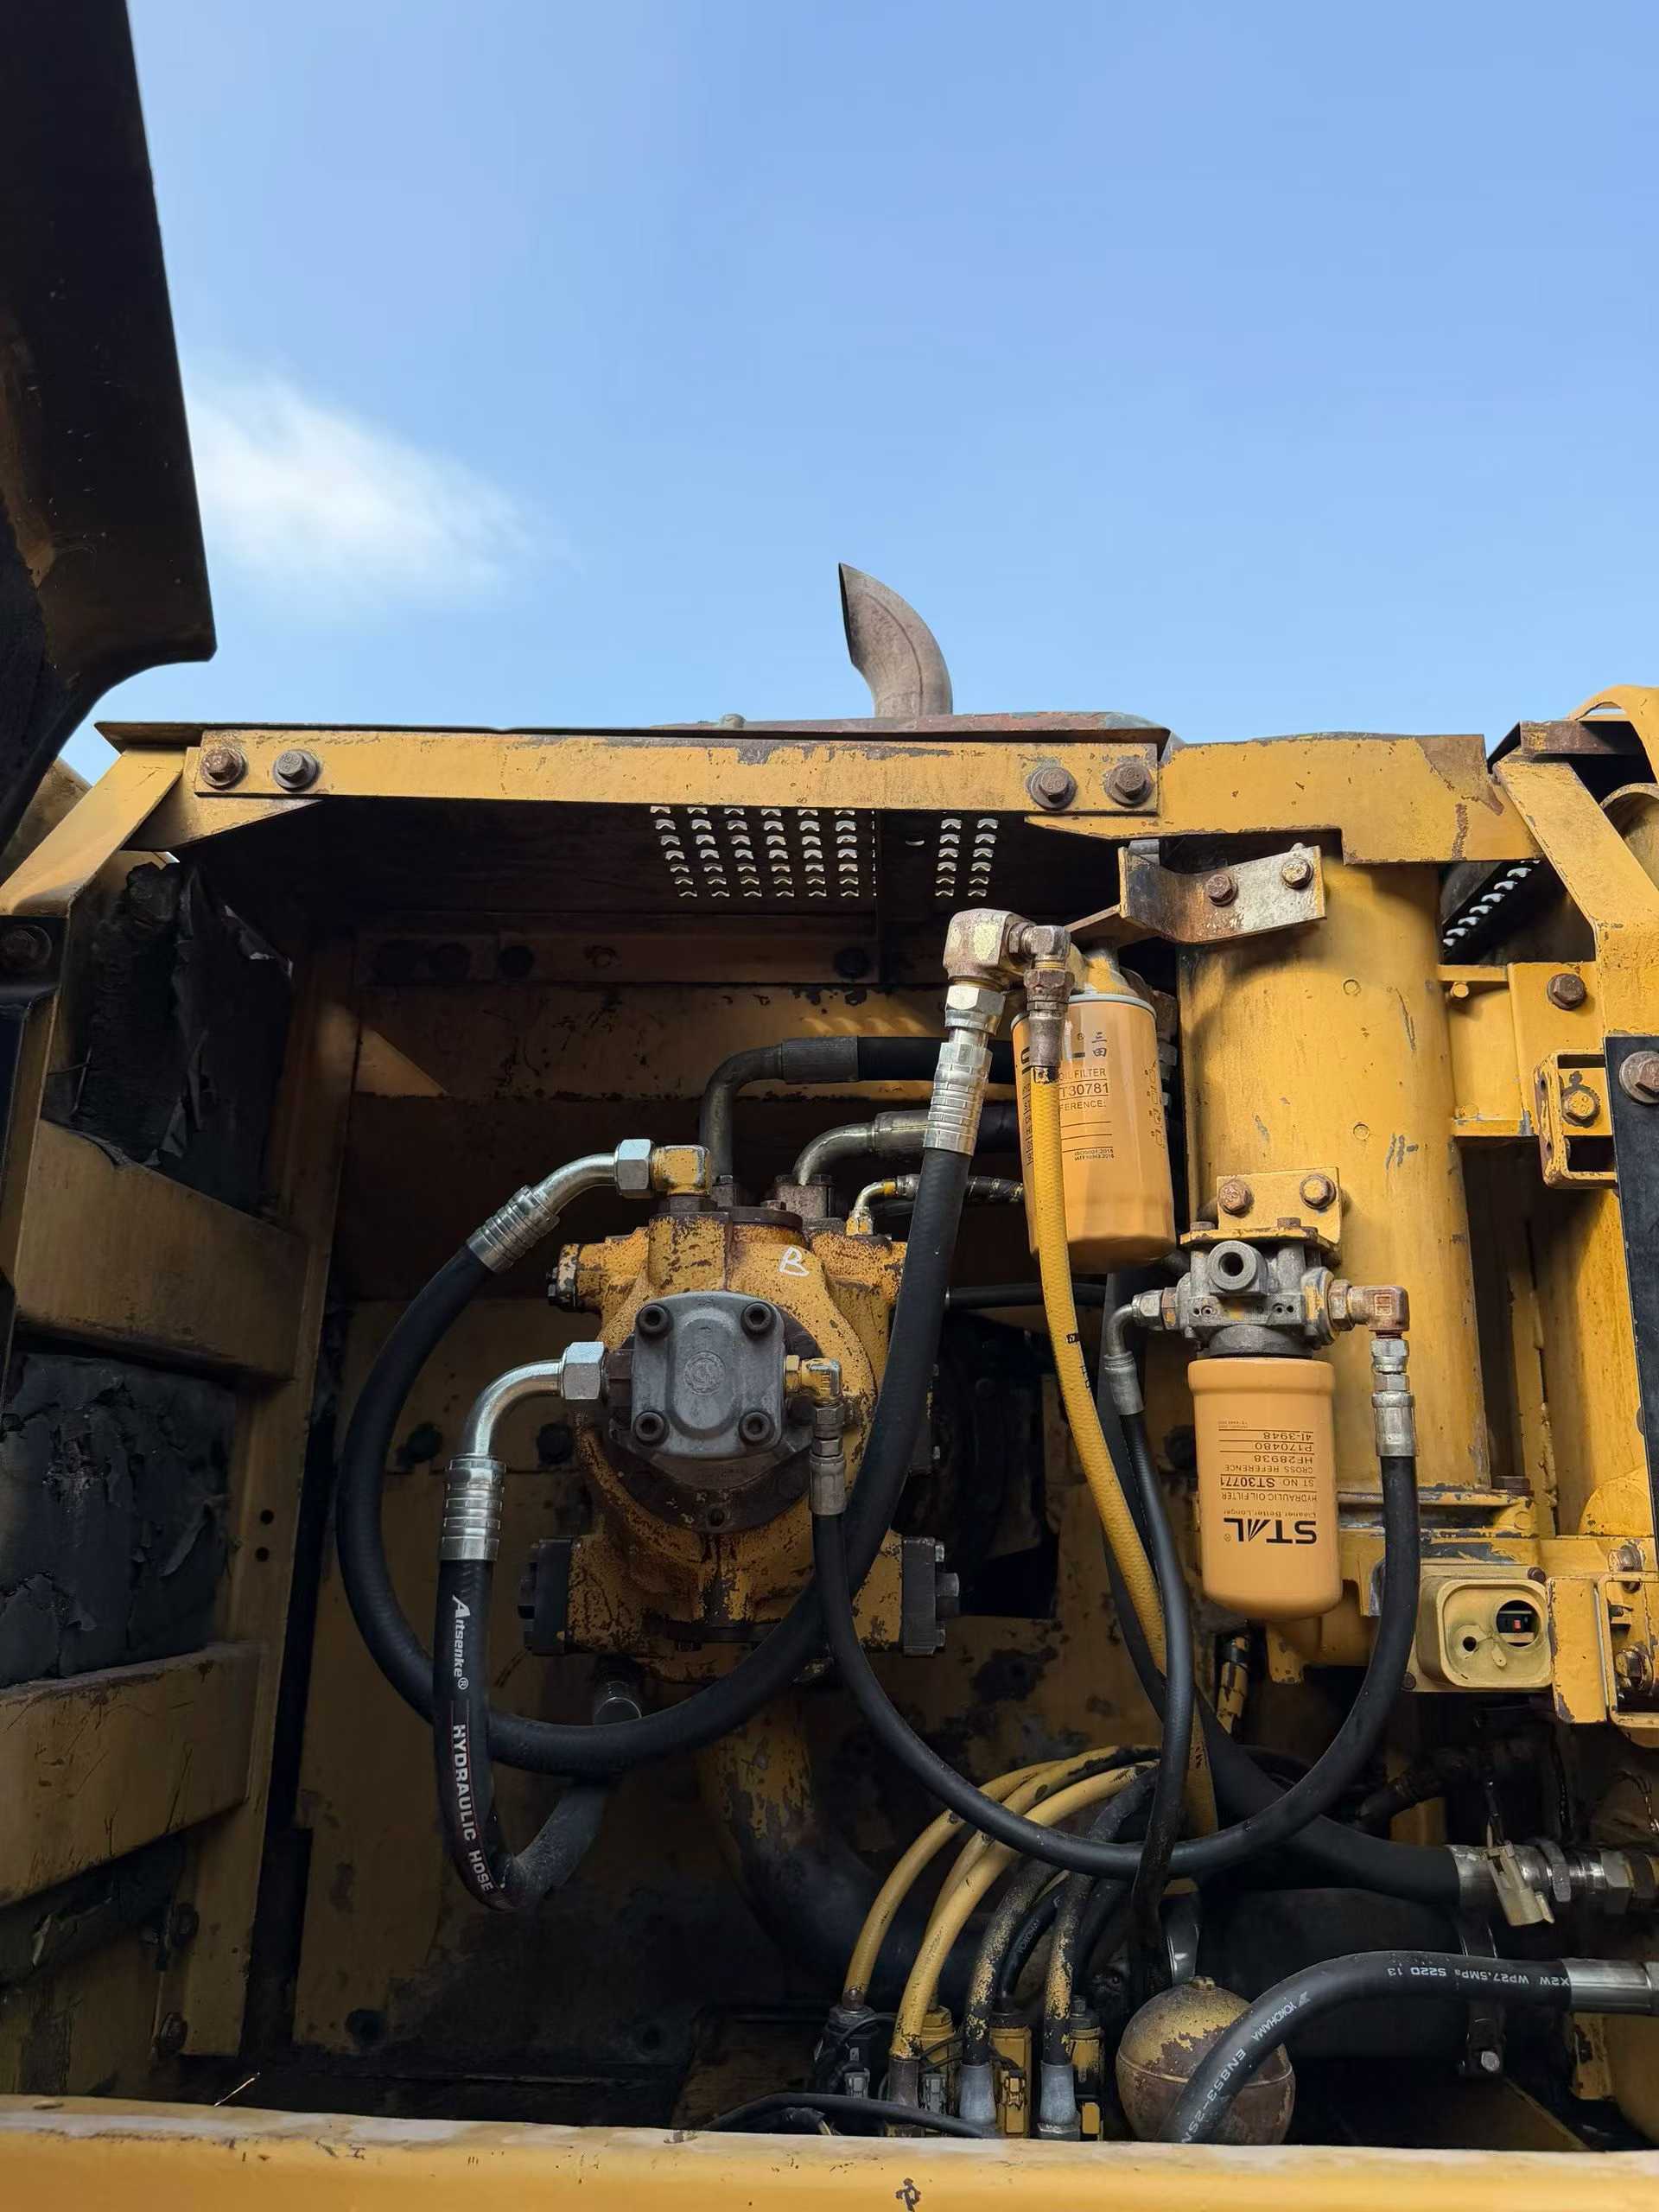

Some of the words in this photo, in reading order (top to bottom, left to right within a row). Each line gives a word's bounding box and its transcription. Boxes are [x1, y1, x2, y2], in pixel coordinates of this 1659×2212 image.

[1074, 1068, 1107, 1079] FILTER
[1059, 1083, 1109, 1097] T30781
[1059, 1100, 1106, 1110] FERENCE:
[779, 1246, 810, 1277] B
[1255, 1442, 1313, 1452] P170480
[1254, 1454, 1313, 1464] HF28938
[1220, 1477, 1275, 1488] ST30771
[1303, 1478, 1314, 1487] ST
[1222, 1491, 1249, 1501] FILTER
[1268, 1493, 1317, 1502] HYDRAULIC
[453, 1724, 476, 1841] HYDRAULIC
[468, 1849, 494, 1891] HOSE
[1251, 2002, 1297, 2042] YOKOHAMA
